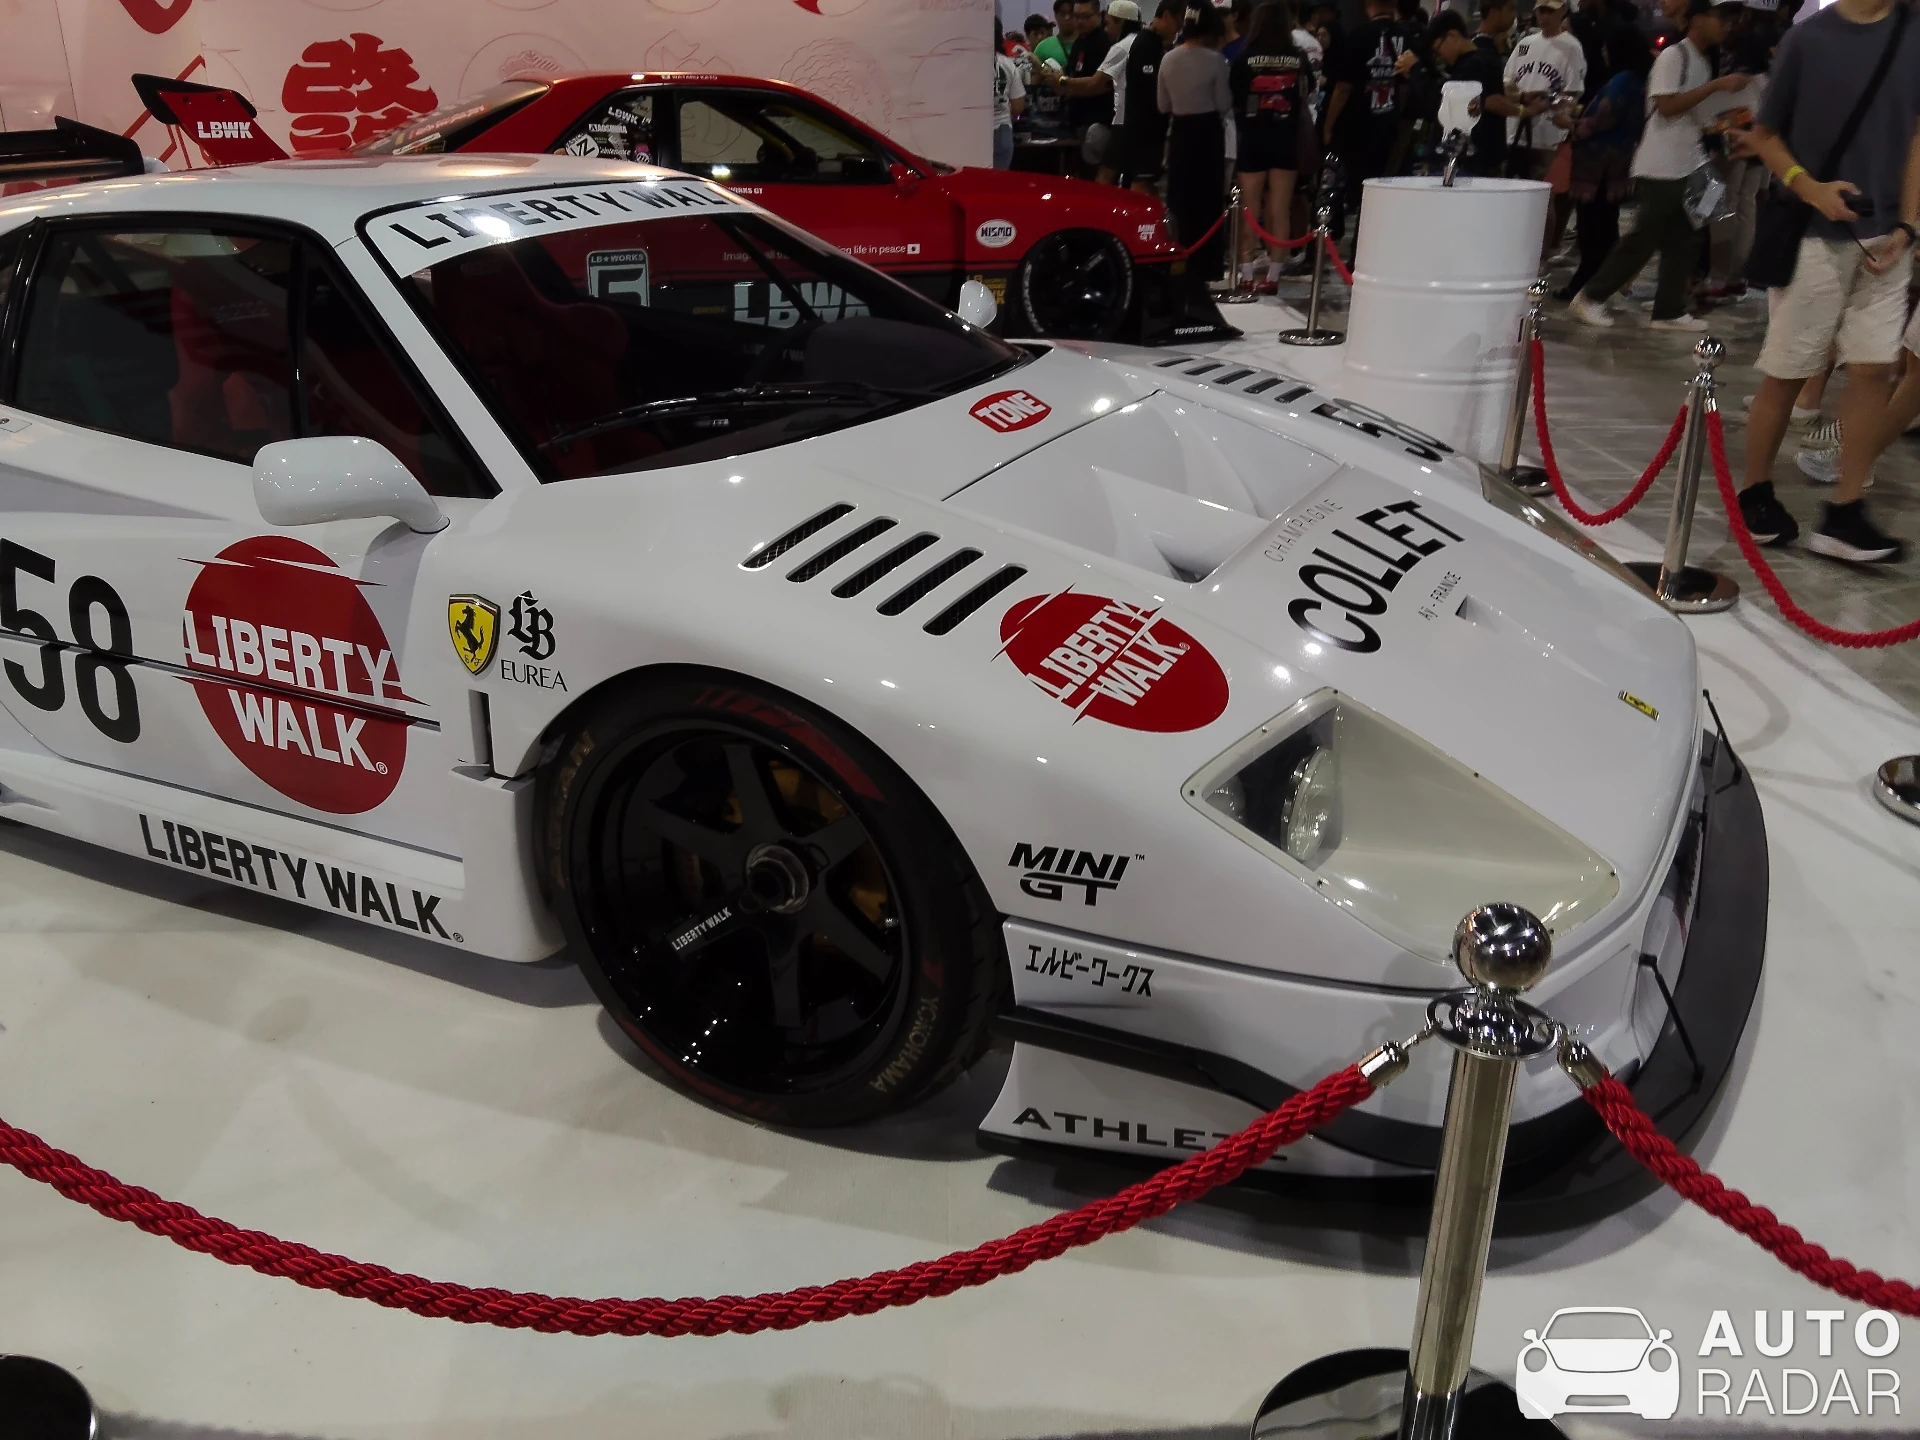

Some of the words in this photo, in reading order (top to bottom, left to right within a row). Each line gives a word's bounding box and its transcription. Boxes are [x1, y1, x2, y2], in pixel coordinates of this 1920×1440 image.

[196, 121, 254, 139] LBWK
[610, 254, 644, 262] WORKS
[853, 245, 868, 254] life
[869, 245, 878, 254] in
[878, 245, 907, 256] peace
[974, 391, 1047, 429] TONE
[1310, 398, 1455, 462] 58
[1264, 498, 1344, 563] CHAMPAGNE
[1287, 500, 1466, 654] COLLET
[1430, 570, 1462, 604] FRANCE
[0, 537, 141, 744] 58
[184, 609, 393, 704] LIBERTY
[1025, 599, 1157, 704] LIBERTY
[1088, 630, 1187, 707] WALK
[500, 659, 568, 692] EUREA
[227, 688, 377, 772] WALK
[139, 813, 307, 899] LIBERTY
[314, 862, 452, 940] WALK
[1007, 842, 1131, 881] MINI
[1019, 872, 1119, 906] GT
[671, 921, 708, 951] LIBERTY
[705, 906, 732, 929] WALK
[1025, 944, 1155, 998] エルビーワークス
[868, 996, 940, 1093] YOKOHAMA
[1012, 1106, 1288, 1162] ATHLE
